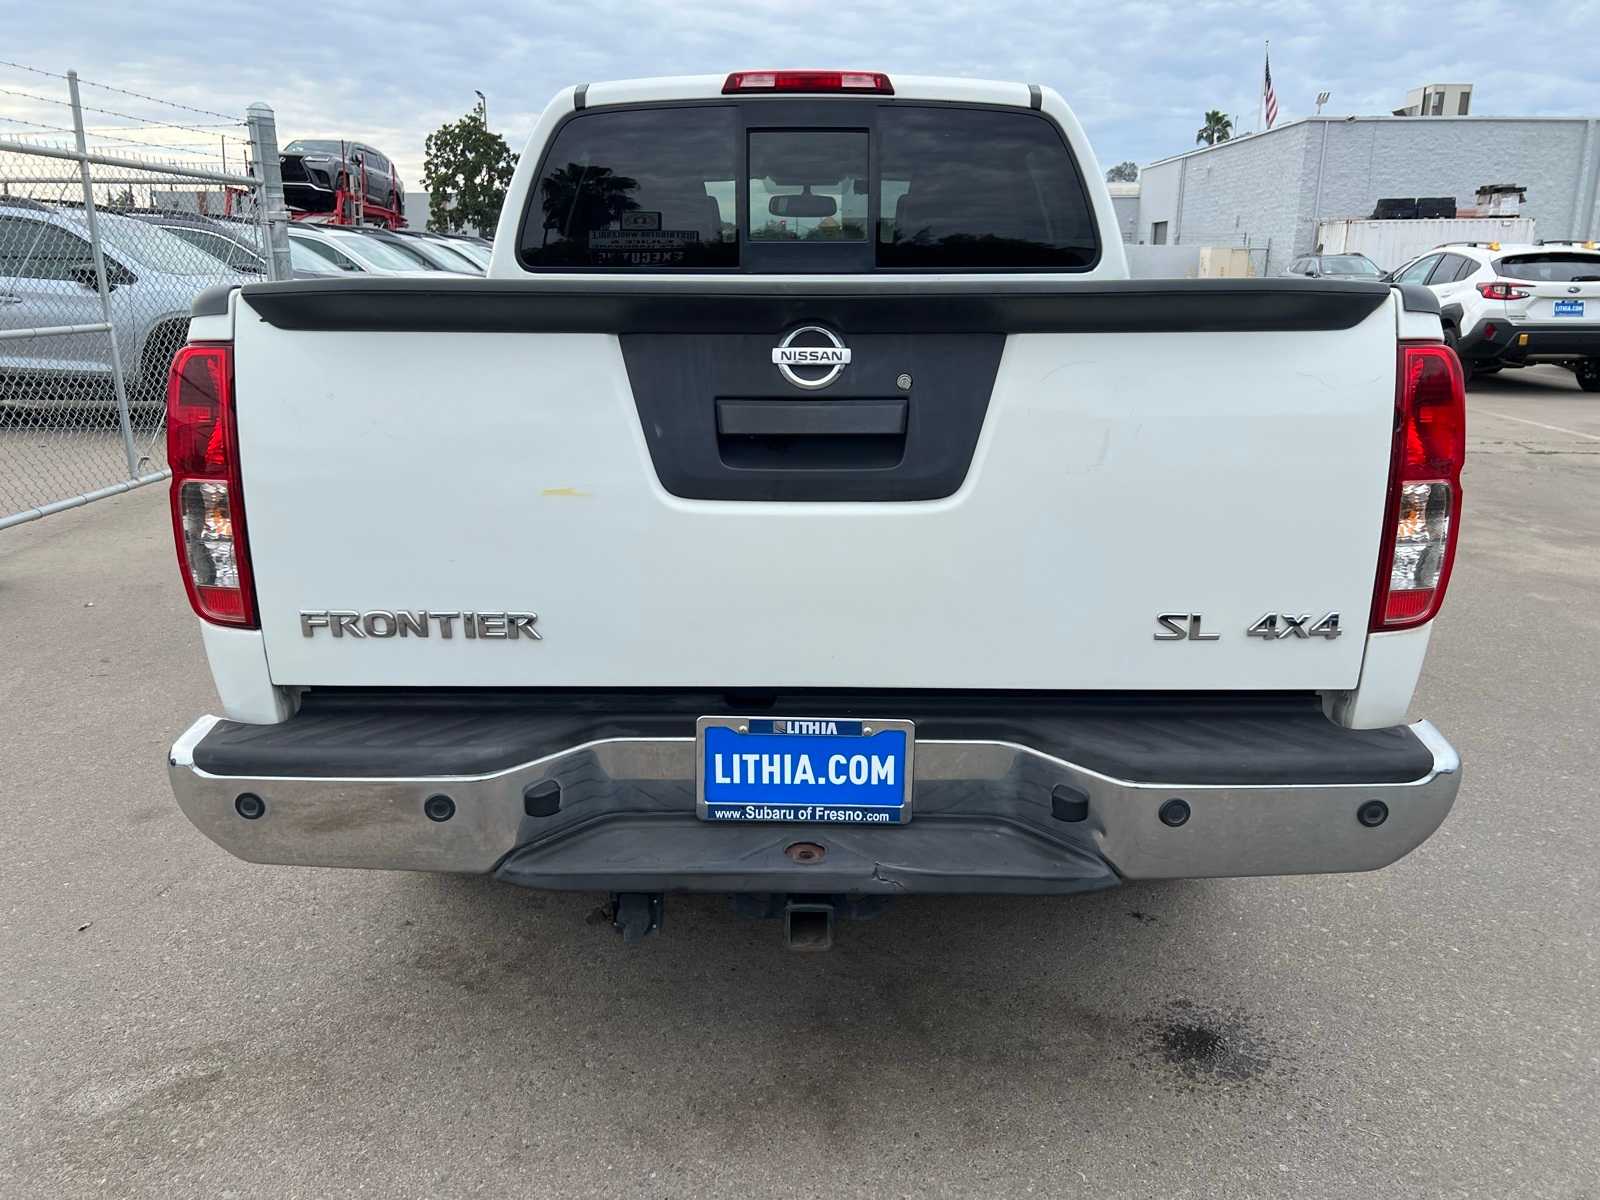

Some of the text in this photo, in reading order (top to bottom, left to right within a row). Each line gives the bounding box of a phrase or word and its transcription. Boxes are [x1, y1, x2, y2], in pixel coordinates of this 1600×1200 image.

[780, 351, 843, 361] NISSAN
[299, 609, 543, 641] FRONTIER
[1153, 611, 1342, 641] SL 4X4
[786, 721, 838, 736] LITHIA
[714, 753, 896, 786] LITHIA.COM
[715, 805, 890, 823] www.Subaru of Fresno.com
